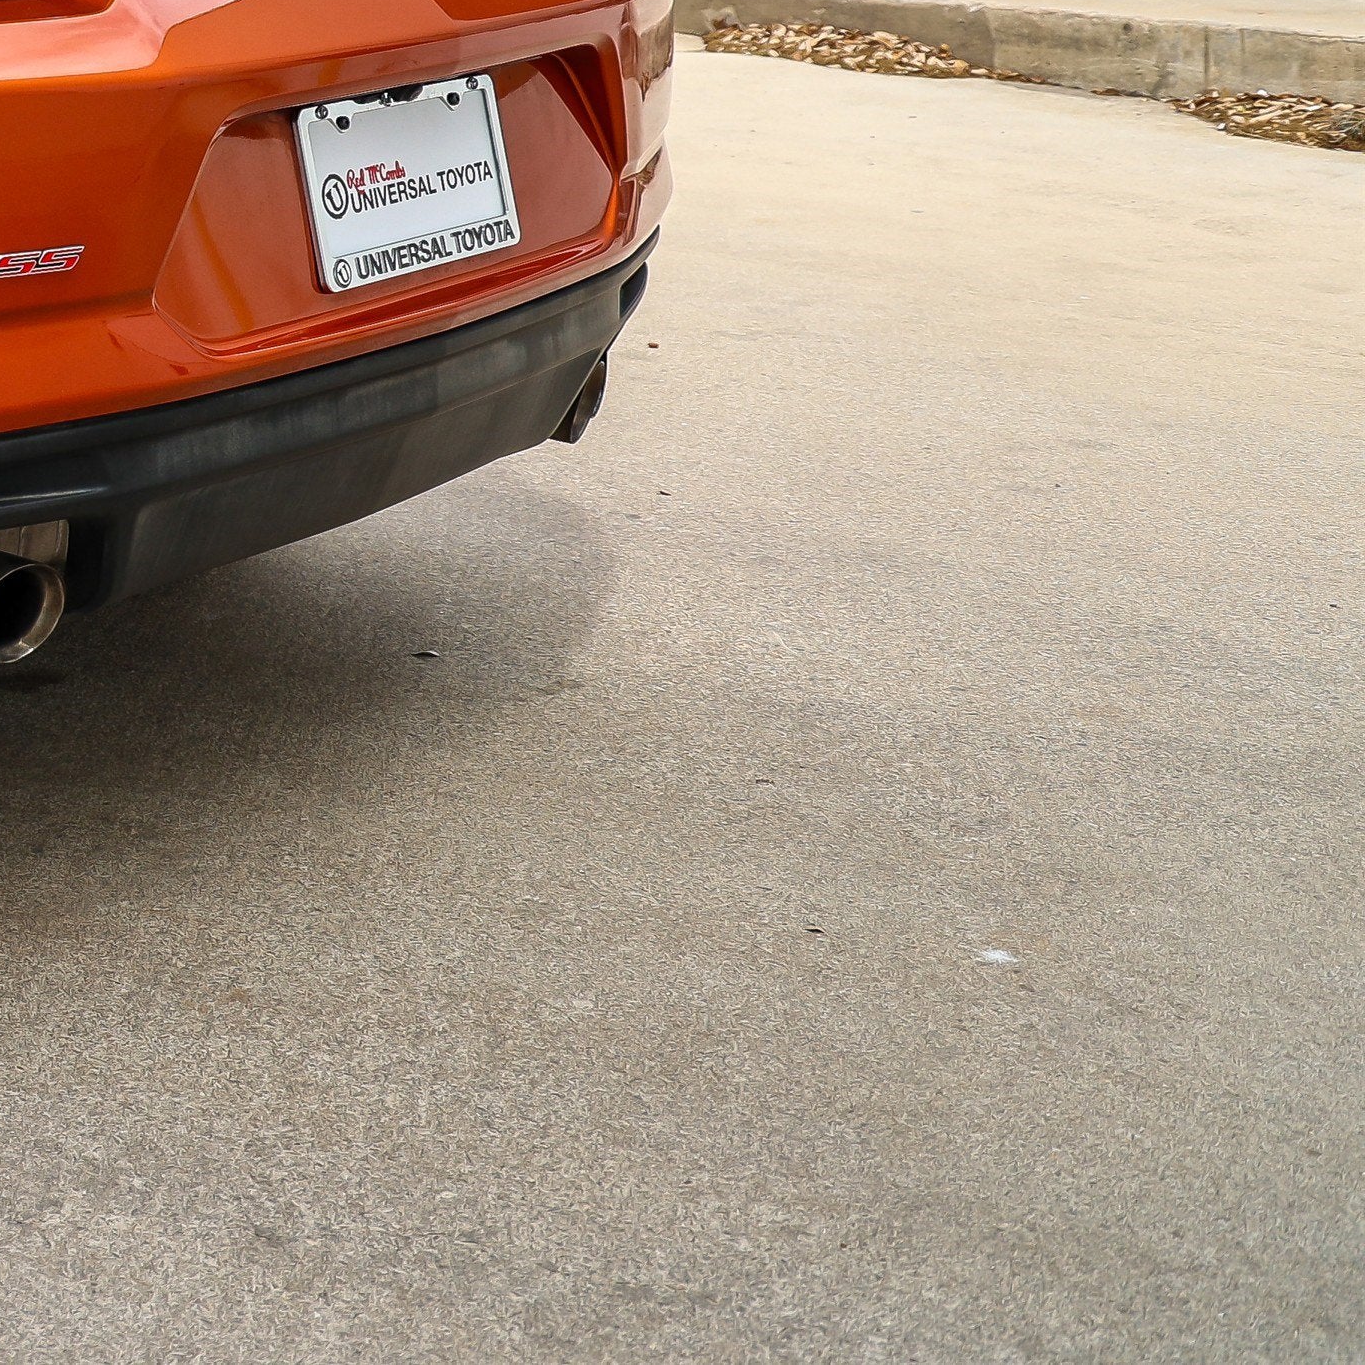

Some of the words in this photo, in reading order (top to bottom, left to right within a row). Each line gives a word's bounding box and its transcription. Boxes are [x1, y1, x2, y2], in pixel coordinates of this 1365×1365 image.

[346, 168, 366, 195] Red
[350, 174, 437, 213] UNIVERSAL
[436, 160, 493, 191] TOYOTA
[355, 235, 453, 280] UNIVERSAL
[451, 219, 516, 253] TOYOTA
